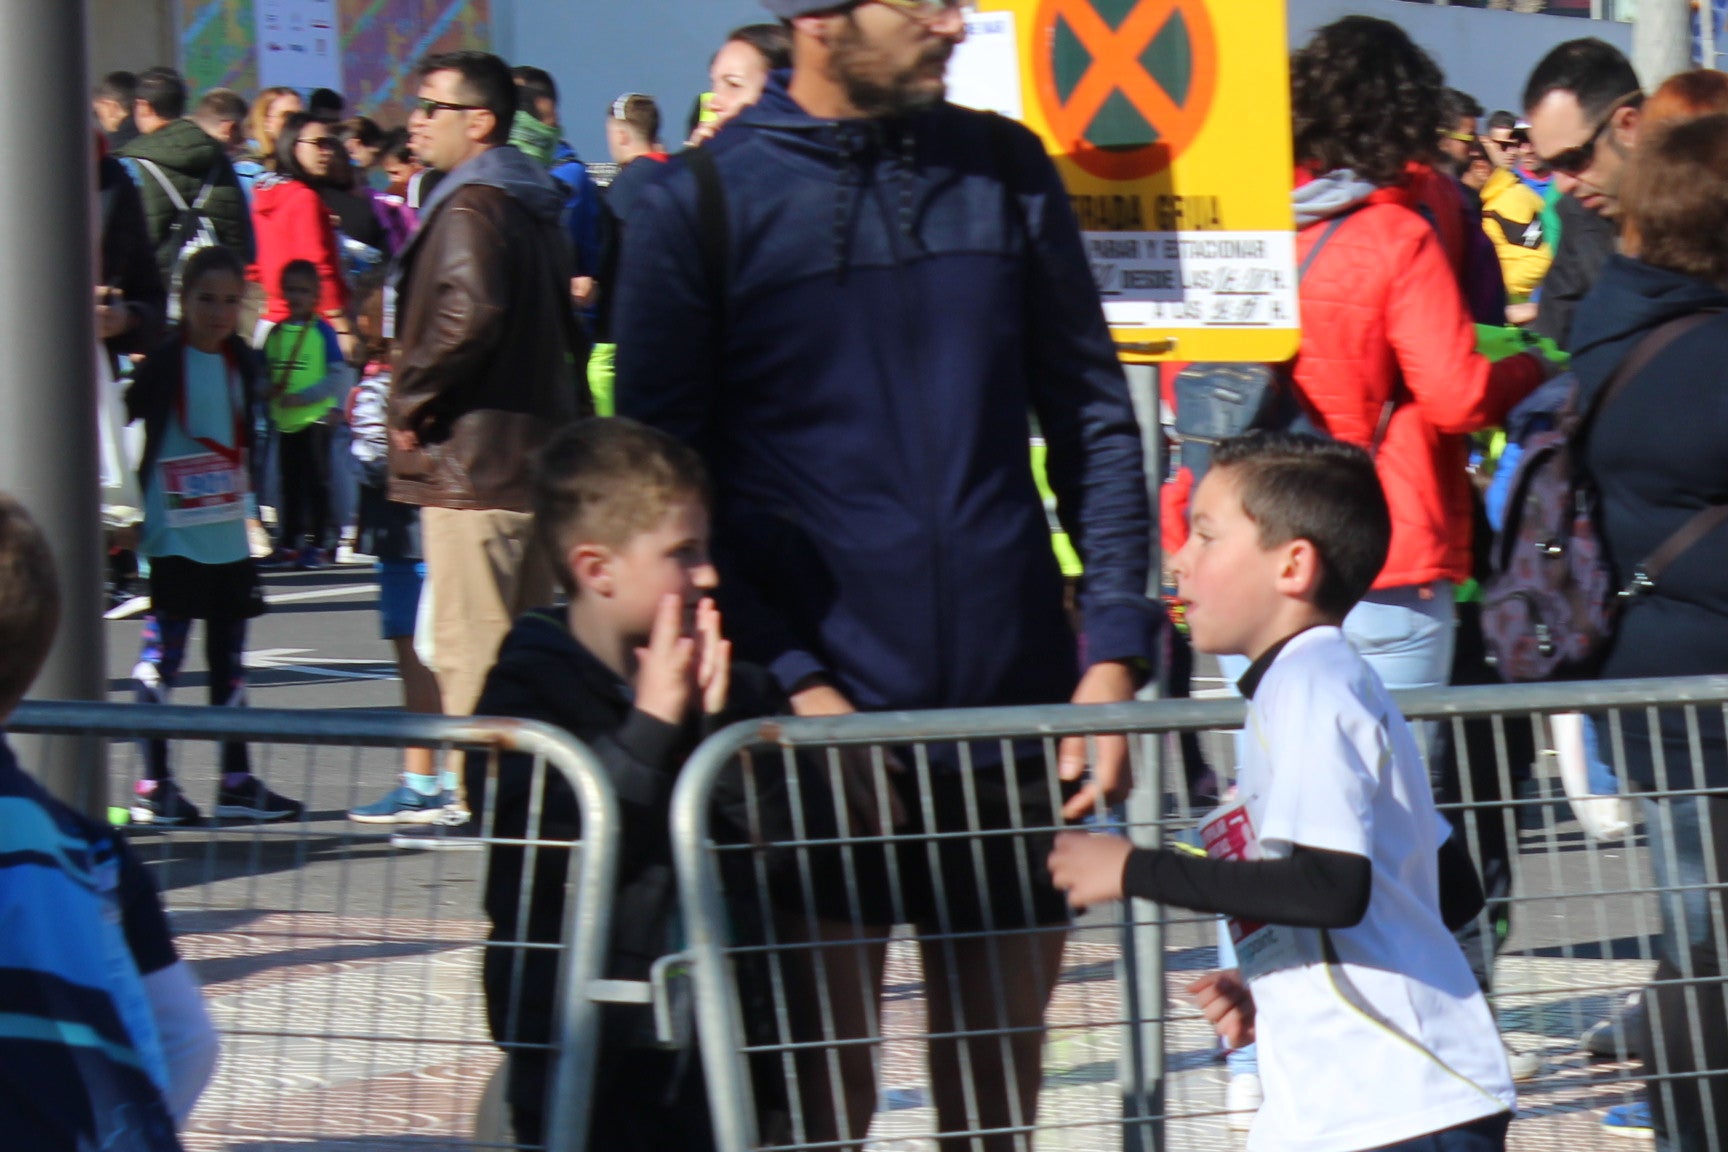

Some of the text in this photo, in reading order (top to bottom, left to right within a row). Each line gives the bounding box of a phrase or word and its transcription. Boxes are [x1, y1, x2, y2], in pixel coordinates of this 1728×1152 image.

[1162, 239, 1266, 259] ESTACIONAR
[1121, 269, 1175, 289] DESDE
[1180, 269, 1213, 289] LAS
